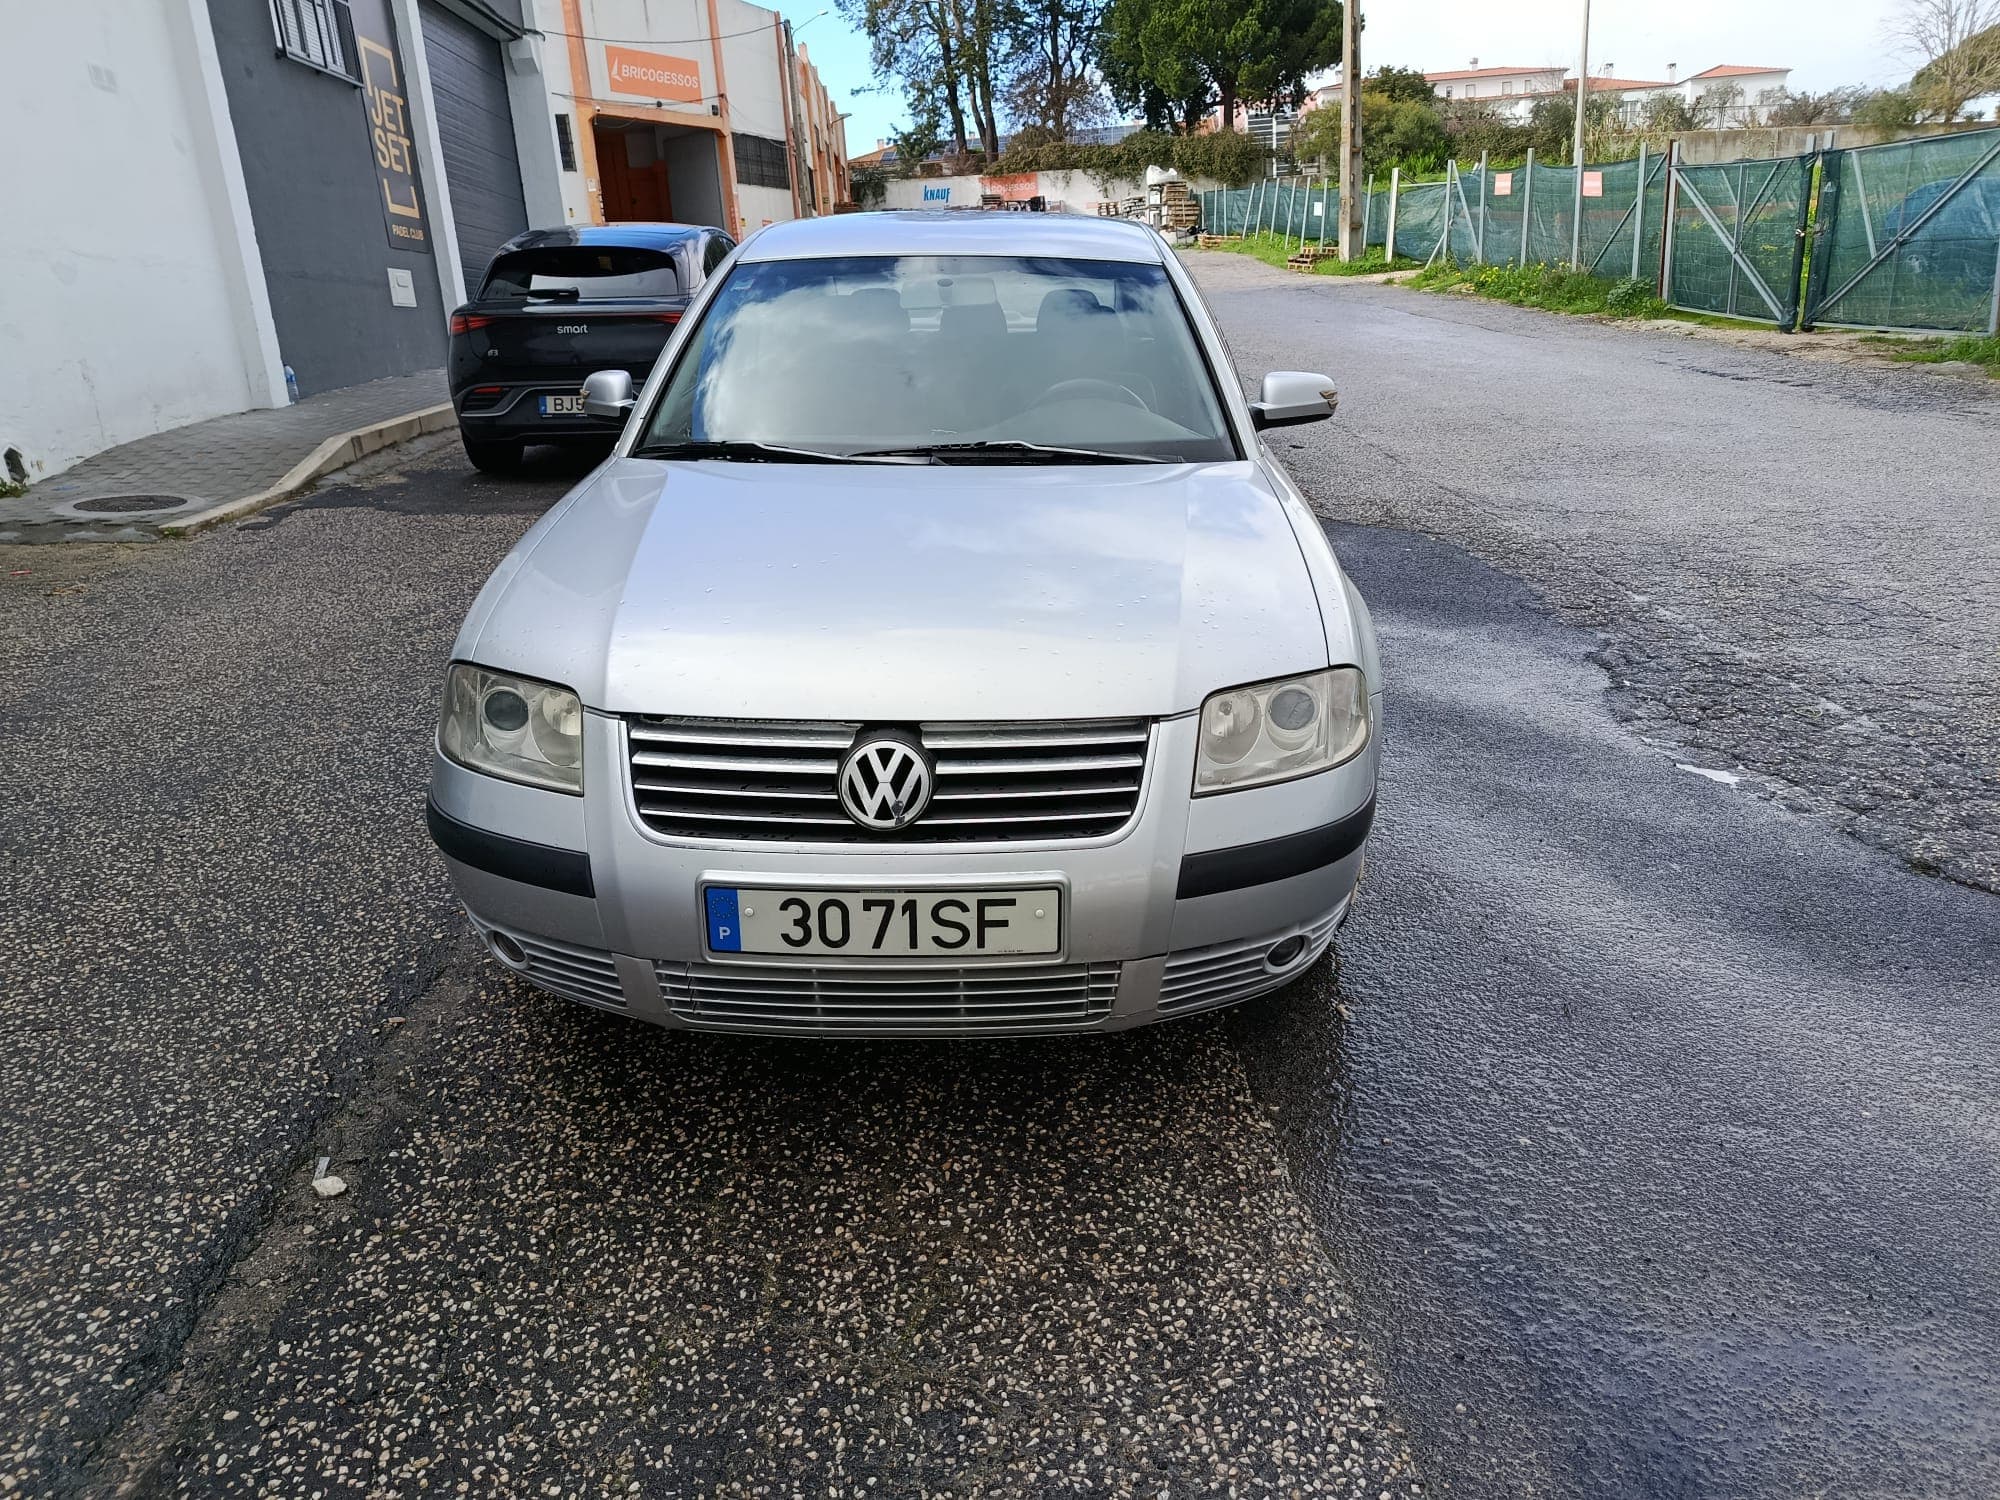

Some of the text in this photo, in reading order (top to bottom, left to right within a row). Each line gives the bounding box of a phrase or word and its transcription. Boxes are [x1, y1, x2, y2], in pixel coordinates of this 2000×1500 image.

[621, 64, 699, 89] BRICOGESSOS
[371, 87, 404, 135] JET
[374, 127, 411, 176] SET
[557, 324, 588, 334] smart
[719, 927, 731, 940] P
